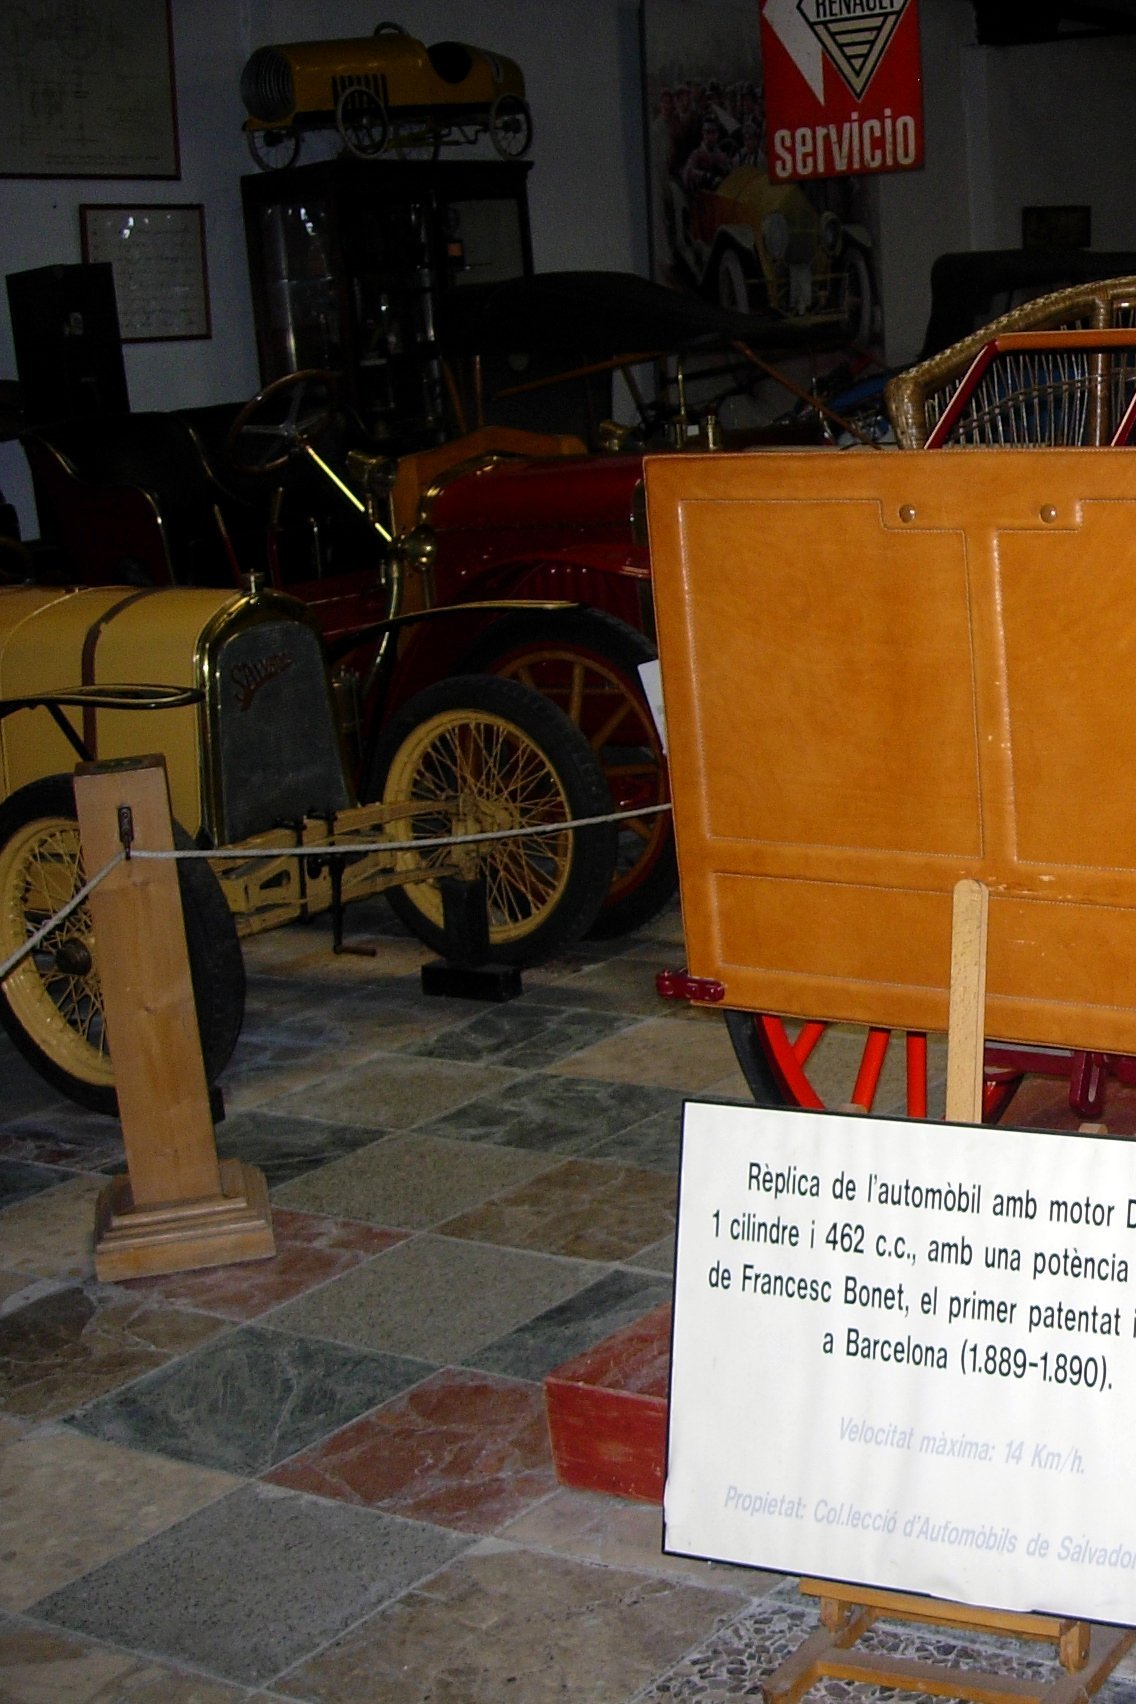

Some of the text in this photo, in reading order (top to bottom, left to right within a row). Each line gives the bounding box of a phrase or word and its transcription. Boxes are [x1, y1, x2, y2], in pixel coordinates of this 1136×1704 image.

[815, 0, 895, 19] RENA
[774, 108, 915, 178] servicio
[748, 1162, 820, 1200] Rèplica
[832, 1170, 856, 1201] de
[992, 1189, 1037, 1220] amb
[1049, 1196, 1115, 1227] motor
[712, 1209, 720, 1238] 1
[730, 1212, 799, 1247] cilindre
[810, 1219, 815, 1250] i
[825, 1222, 865, 1254] 462
[876, 1234, 916, 1267] c.c.,
[928, 1235, 973, 1266] amb
[985, 1246, 1021, 1272] una
[1033, 1247, 1128, 1283] potència
[709, 1259, 731, 1290] de
[742, 1263, 832, 1303] Francesc
[844, 1275, 909, 1318] Bonet,
[921, 1285, 938, 1316] el
[948, 1290, 1018, 1324] primer
[1028, 1301, 1121, 1336] patentat
[823, 1327, 1112, 1392] a Barcelona (1.889-1.890).
[841, 1417, 1084, 1474] Velocitat màxima: 14 Km/h.
[725, 1486, 806, 1519] Propietat:
[814, 1499, 898, 1534] Col.lecció
[1027, 1533, 1049, 1558] de
